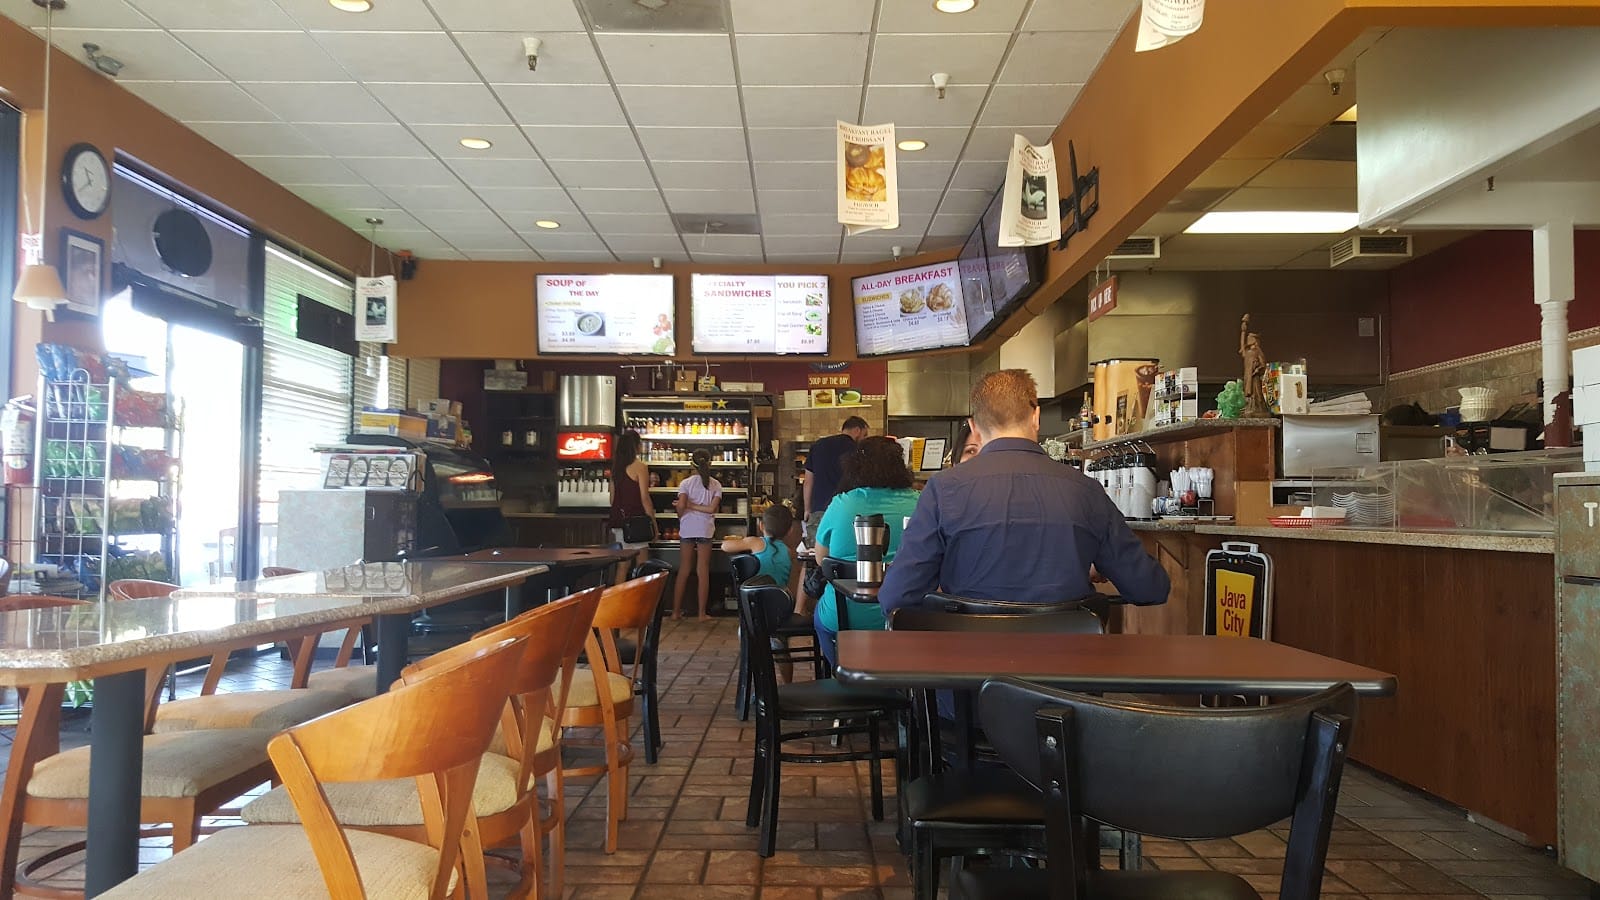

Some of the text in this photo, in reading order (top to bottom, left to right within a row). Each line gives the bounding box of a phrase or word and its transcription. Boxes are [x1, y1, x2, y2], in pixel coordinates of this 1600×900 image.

[546, 279, 574, 287] SOUP
[861, 279, 892, 291] ALL-DAY
[894, 267, 953, 285] BREAKFAST
[703, 289, 772, 298] SANDWICHES
[808, 377, 849, 385] SOUP OF THE DAY
[1220, 585, 1246, 610] Java
[1223, 609, 1245, 637] City
